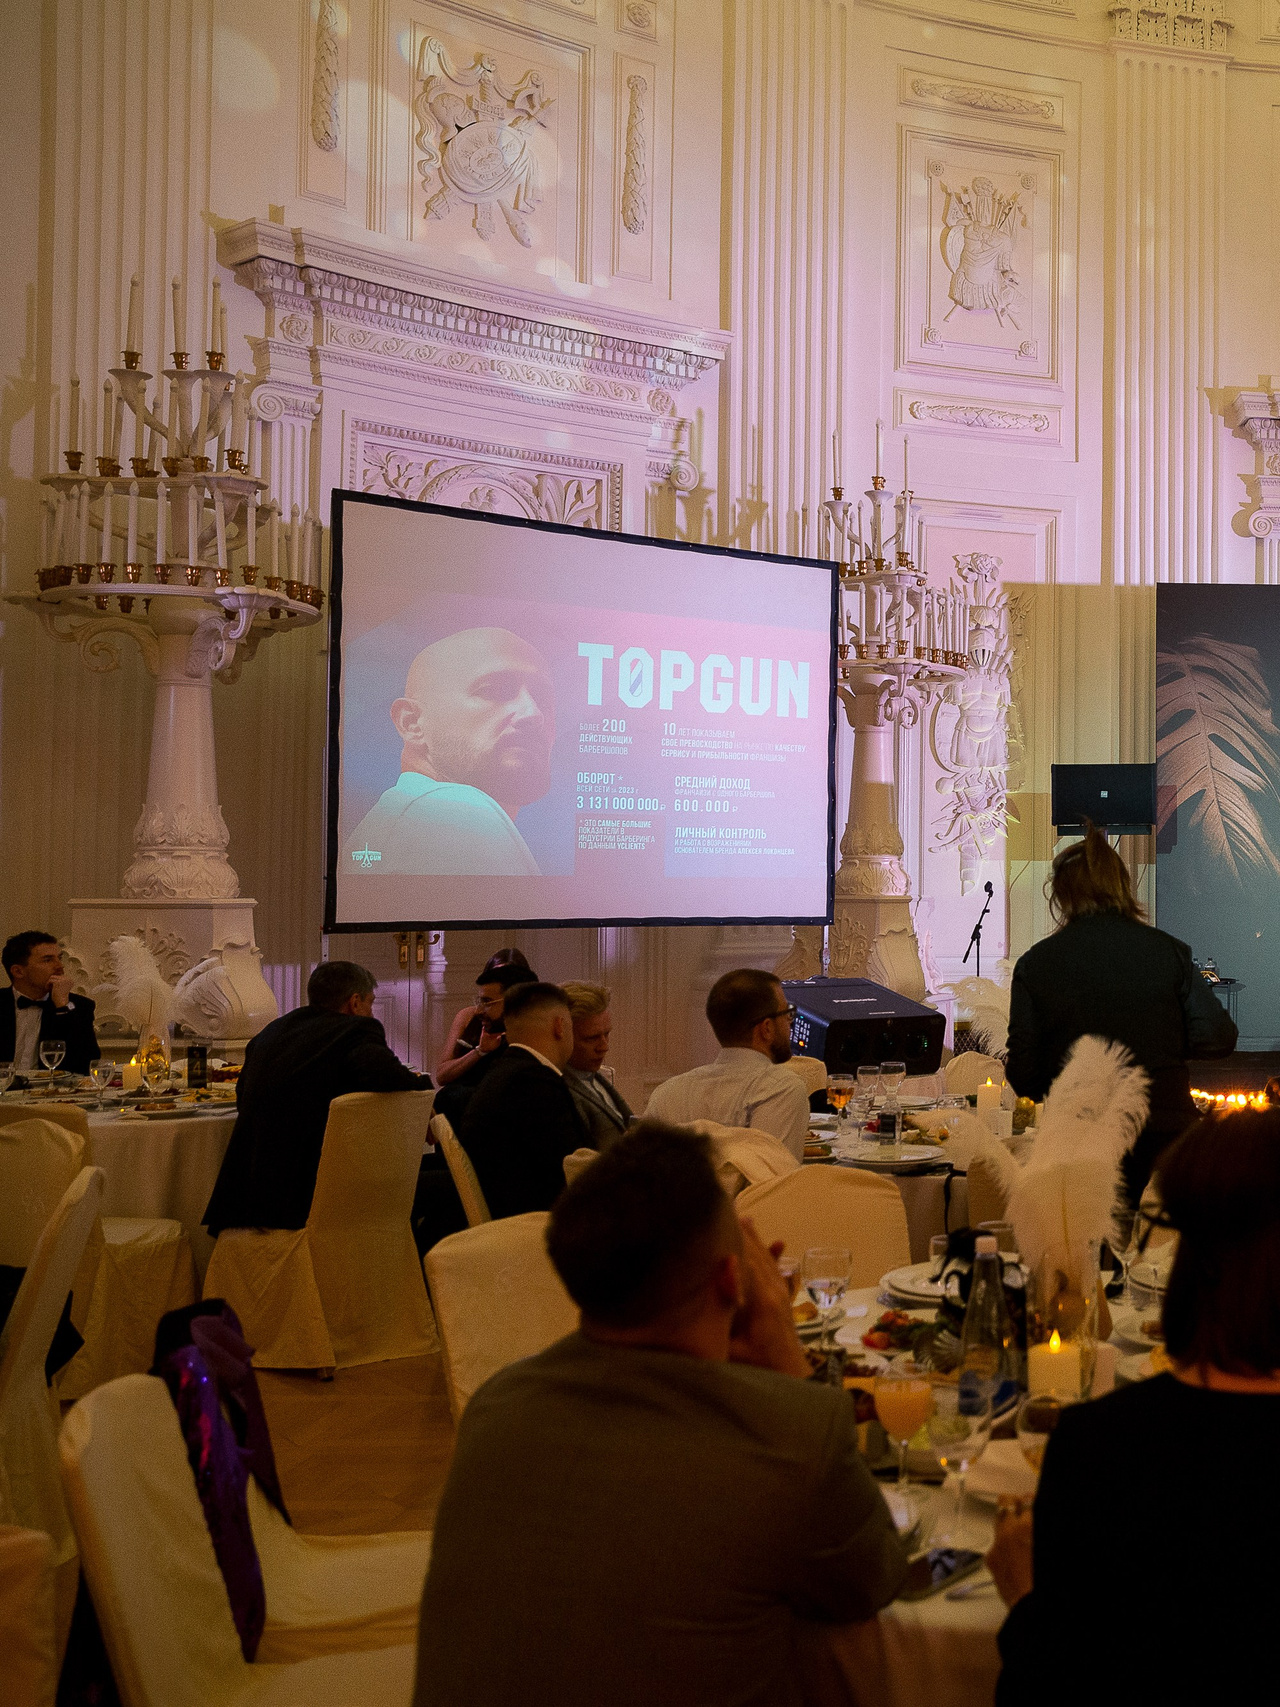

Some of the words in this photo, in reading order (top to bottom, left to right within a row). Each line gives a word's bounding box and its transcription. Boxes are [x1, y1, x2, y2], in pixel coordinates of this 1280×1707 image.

[577, 642, 810, 719] TOPGUN
[579, 723, 600, 731] БОЛЕЕ
[602, 719, 626, 732] 200
[663, 722, 677, 735] 10
[678, 727, 691, 736] ЛЕТ
[692, 728, 735, 738] ПОКАЗЫВАЕМ
[579, 733, 633, 744] ДЕЙСТВУЮЩИХ
[661, 738, 678, 747] СВОЕ
[679, 738, 733, 749] ПРЕВОСХОДСТВО
[579, 745, 629, 755] БАРБЕРШОПОВ
[661, 748, 690, 758] СЕРВИСУ
[697, 750, 749, 761] ПРИБЫЛЬНОСТИ
[577, 772, 616, 784] ОБОРОТ
[674, 775, 717, 789] СРЕДНИЙ
[718, 777, 751, 790] ДОХОД
[594, 785, 610, 793] СЕТИ
[618, 786, 635, 794] 2023
[576, 795, 584, 809] 3
[589, 796, 609, 809] 131
[612, 797, 635, 810] 000
[674, 799, 730, 813] 600.000
[597, 819, 621, 828] САМЫЕ
[622, 820, 652, 828] БОЛЬШИЕ
[578, 827, 620, 835] ПОКАЗАТЕЛИ
[674, 826, 716, 838] ЛИЧНЫЙ
[719, 827, 767, 840] КОНТРОЛЬ
[578, 841, 587, 849] ПО
[617, 842, 646, 850] YCLIENTS
